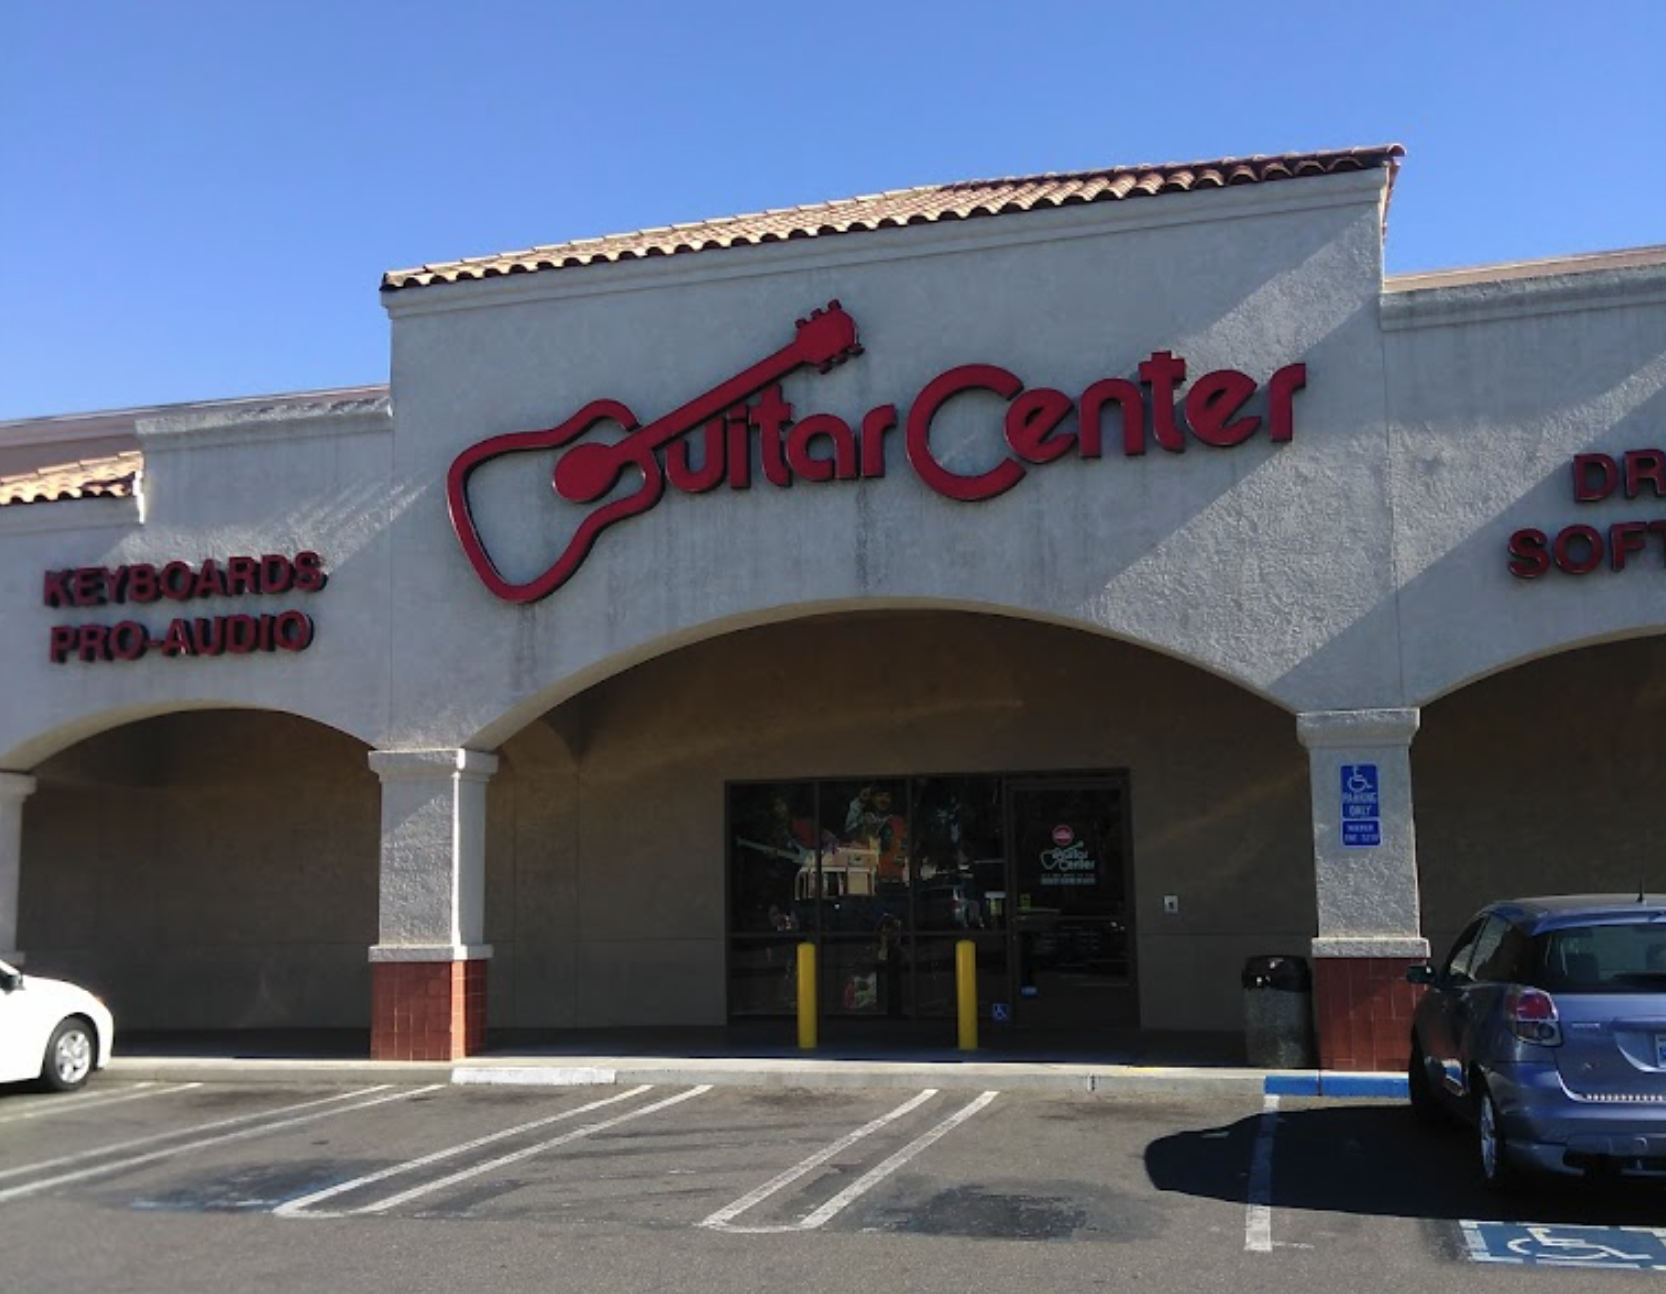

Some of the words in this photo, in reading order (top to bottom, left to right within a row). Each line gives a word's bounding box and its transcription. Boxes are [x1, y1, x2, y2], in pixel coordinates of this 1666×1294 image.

[447, 299, 896, 603] Guitar
[906, 350, 1306, 502] Center
[44, 551, 326, 607] KEYBOARDS
[49, 609, 314, 664] PRO-AUDIO
